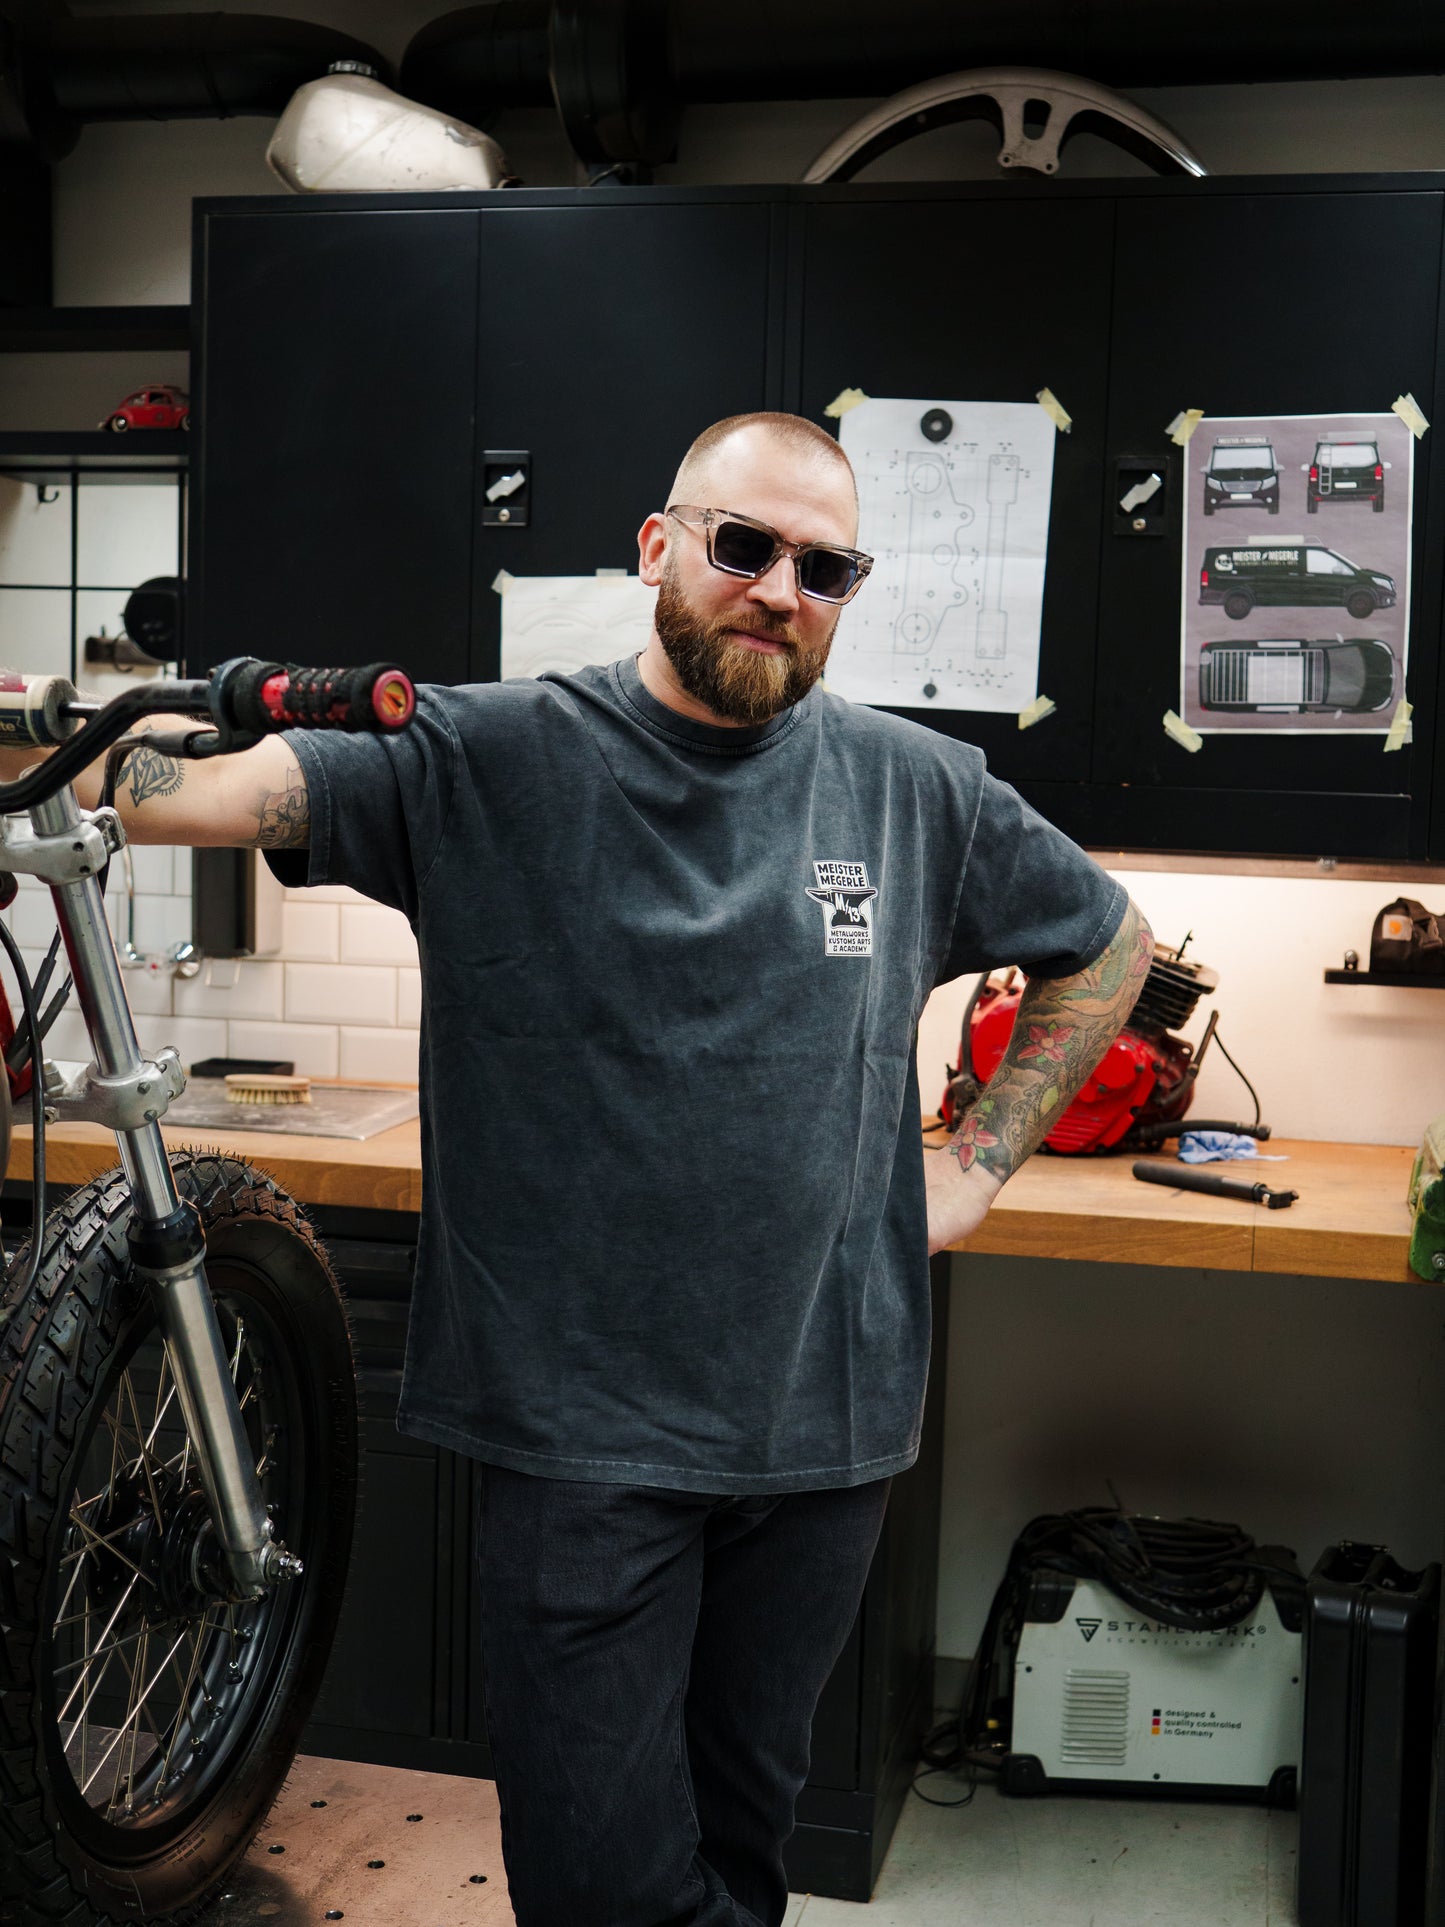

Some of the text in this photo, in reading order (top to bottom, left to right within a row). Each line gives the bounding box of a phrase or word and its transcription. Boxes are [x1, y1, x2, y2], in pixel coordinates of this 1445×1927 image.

[818, 864, 862, 875] MEISTER
[820, 875, 865, 887] MEGERLE
[1165, 1710, 1206, 1719] designed
[1164, 1719, 1242, 1729] quality controlled
[1174, 1728, 1213, 1738] Germany
